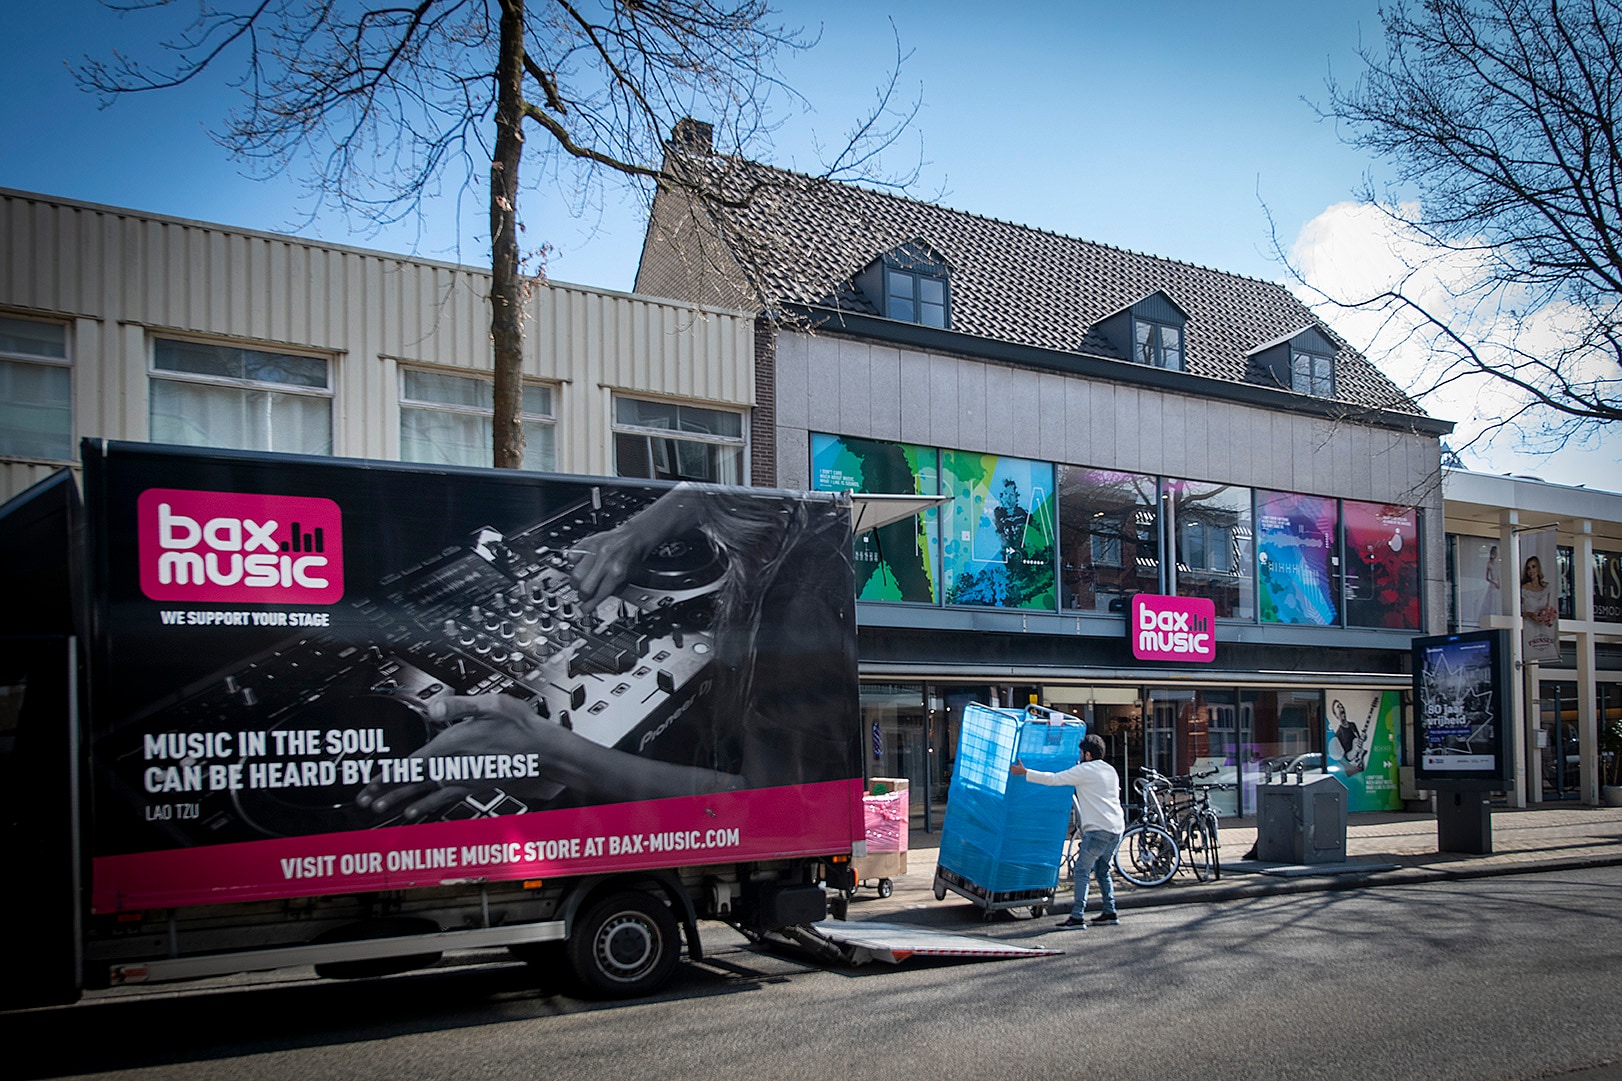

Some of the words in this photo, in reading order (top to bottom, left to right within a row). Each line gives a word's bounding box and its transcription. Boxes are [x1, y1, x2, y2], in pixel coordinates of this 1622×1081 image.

[158, 503, 279, 552] bax
[160, 611, 186, 625] WE
[187, 611, 250, 626] SUPPORT
[251, 612, 288, 627] YOUR
[288, 613, 330, 627] STAGE
[1139, 602, 1189, 632] bax
[144, 732, 233, 760] MUSIC
[238, 731, 267, 757] IN
[271, 730, 322, 756] THE
[325, 728, 391, 754] SOUL
[144, 765, 203, 793] CAN
[209, 764, 245, 791] BE
[249, 760, 337, 789] HEARD
[342, 759, 375, 785] BY
[378, 757, 425, 783] THE
[428, 753, 541, 782] UNIVERSE
[145, 804, 172, 821] LAO
[175, 803, 200, 820] TZU
[280, 855, 337, 879] VISIT
[340, 852, 384, 876] OUR
[386, 847, 458, 872] ONLINE
[461, 842, 521, 867] MUSIC
[524, 838, 581, 862] STORE
[584, 836, 606, 857] AT
[608, 828, 741, 856] BAX-MUSIC.COM
